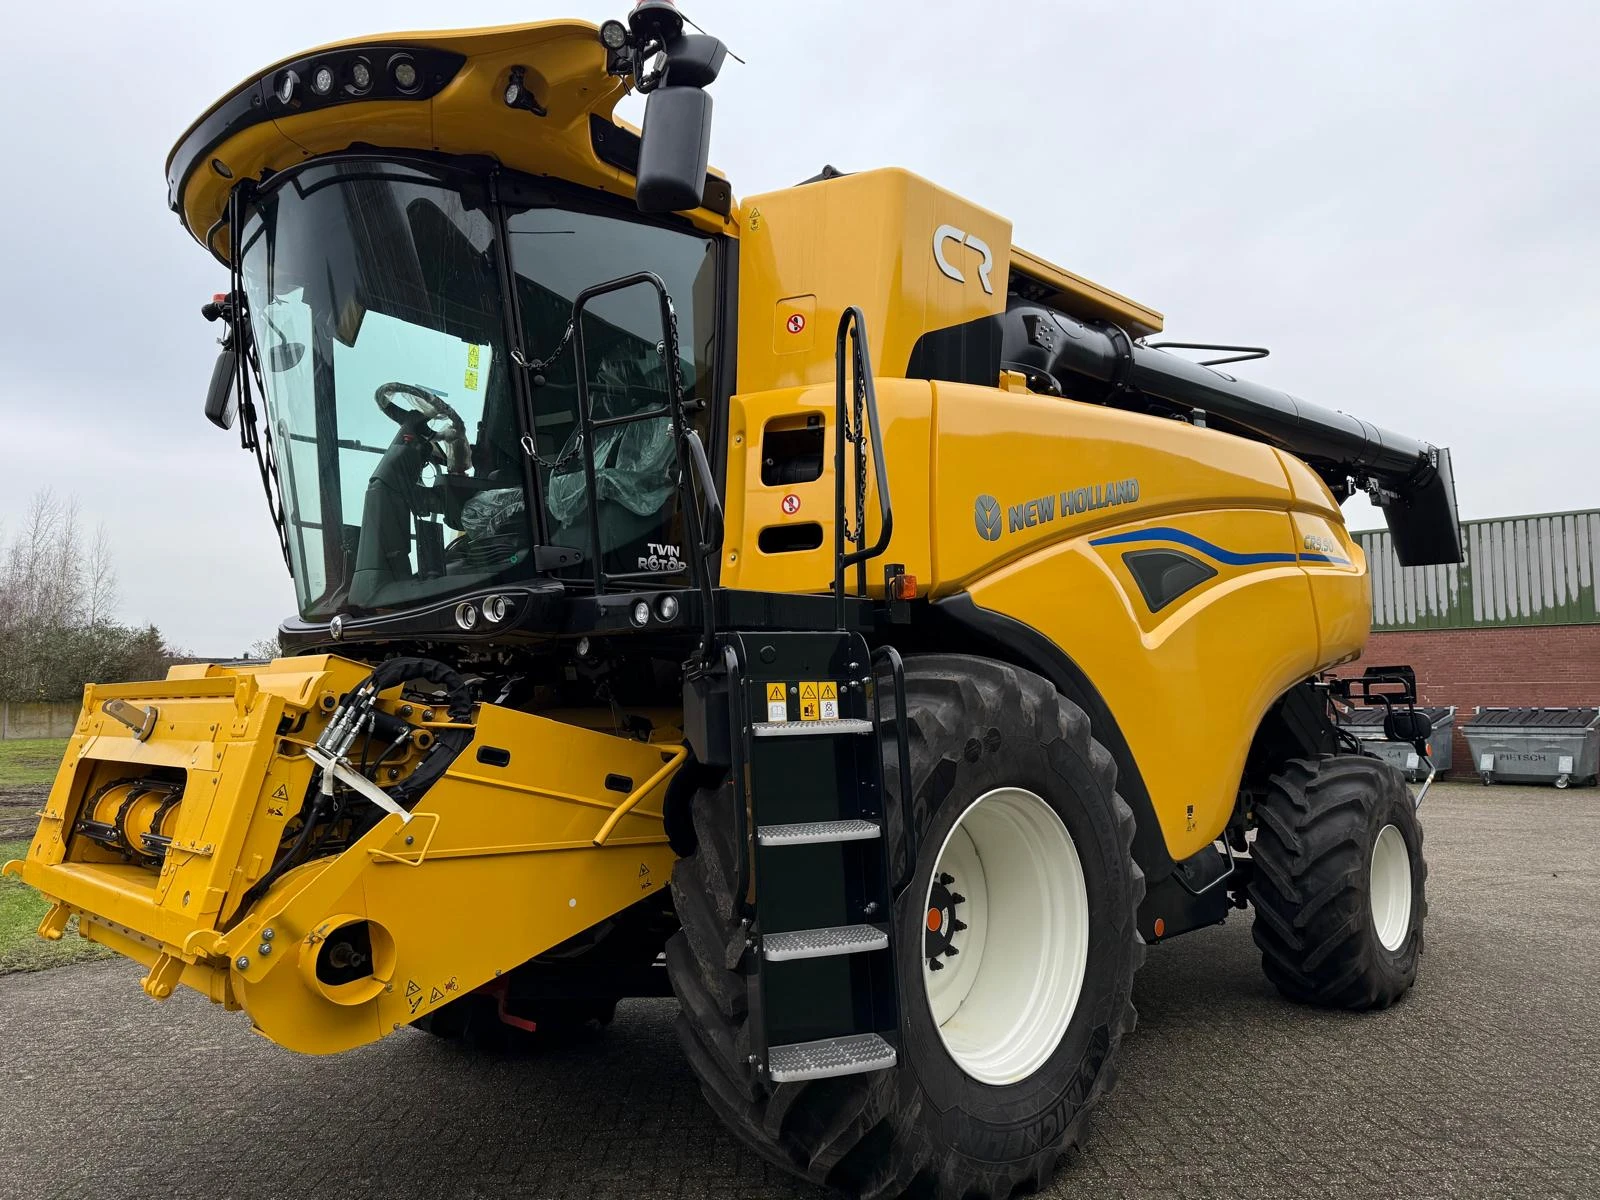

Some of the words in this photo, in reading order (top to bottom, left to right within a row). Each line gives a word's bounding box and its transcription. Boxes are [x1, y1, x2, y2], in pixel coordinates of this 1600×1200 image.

[932, 224, 993, 295] CR
[1008, 495, 1055, 533] NEW
[1060, 478, 1139, 517] HOLLAND
[647, 543, 680, 557] TWIN
